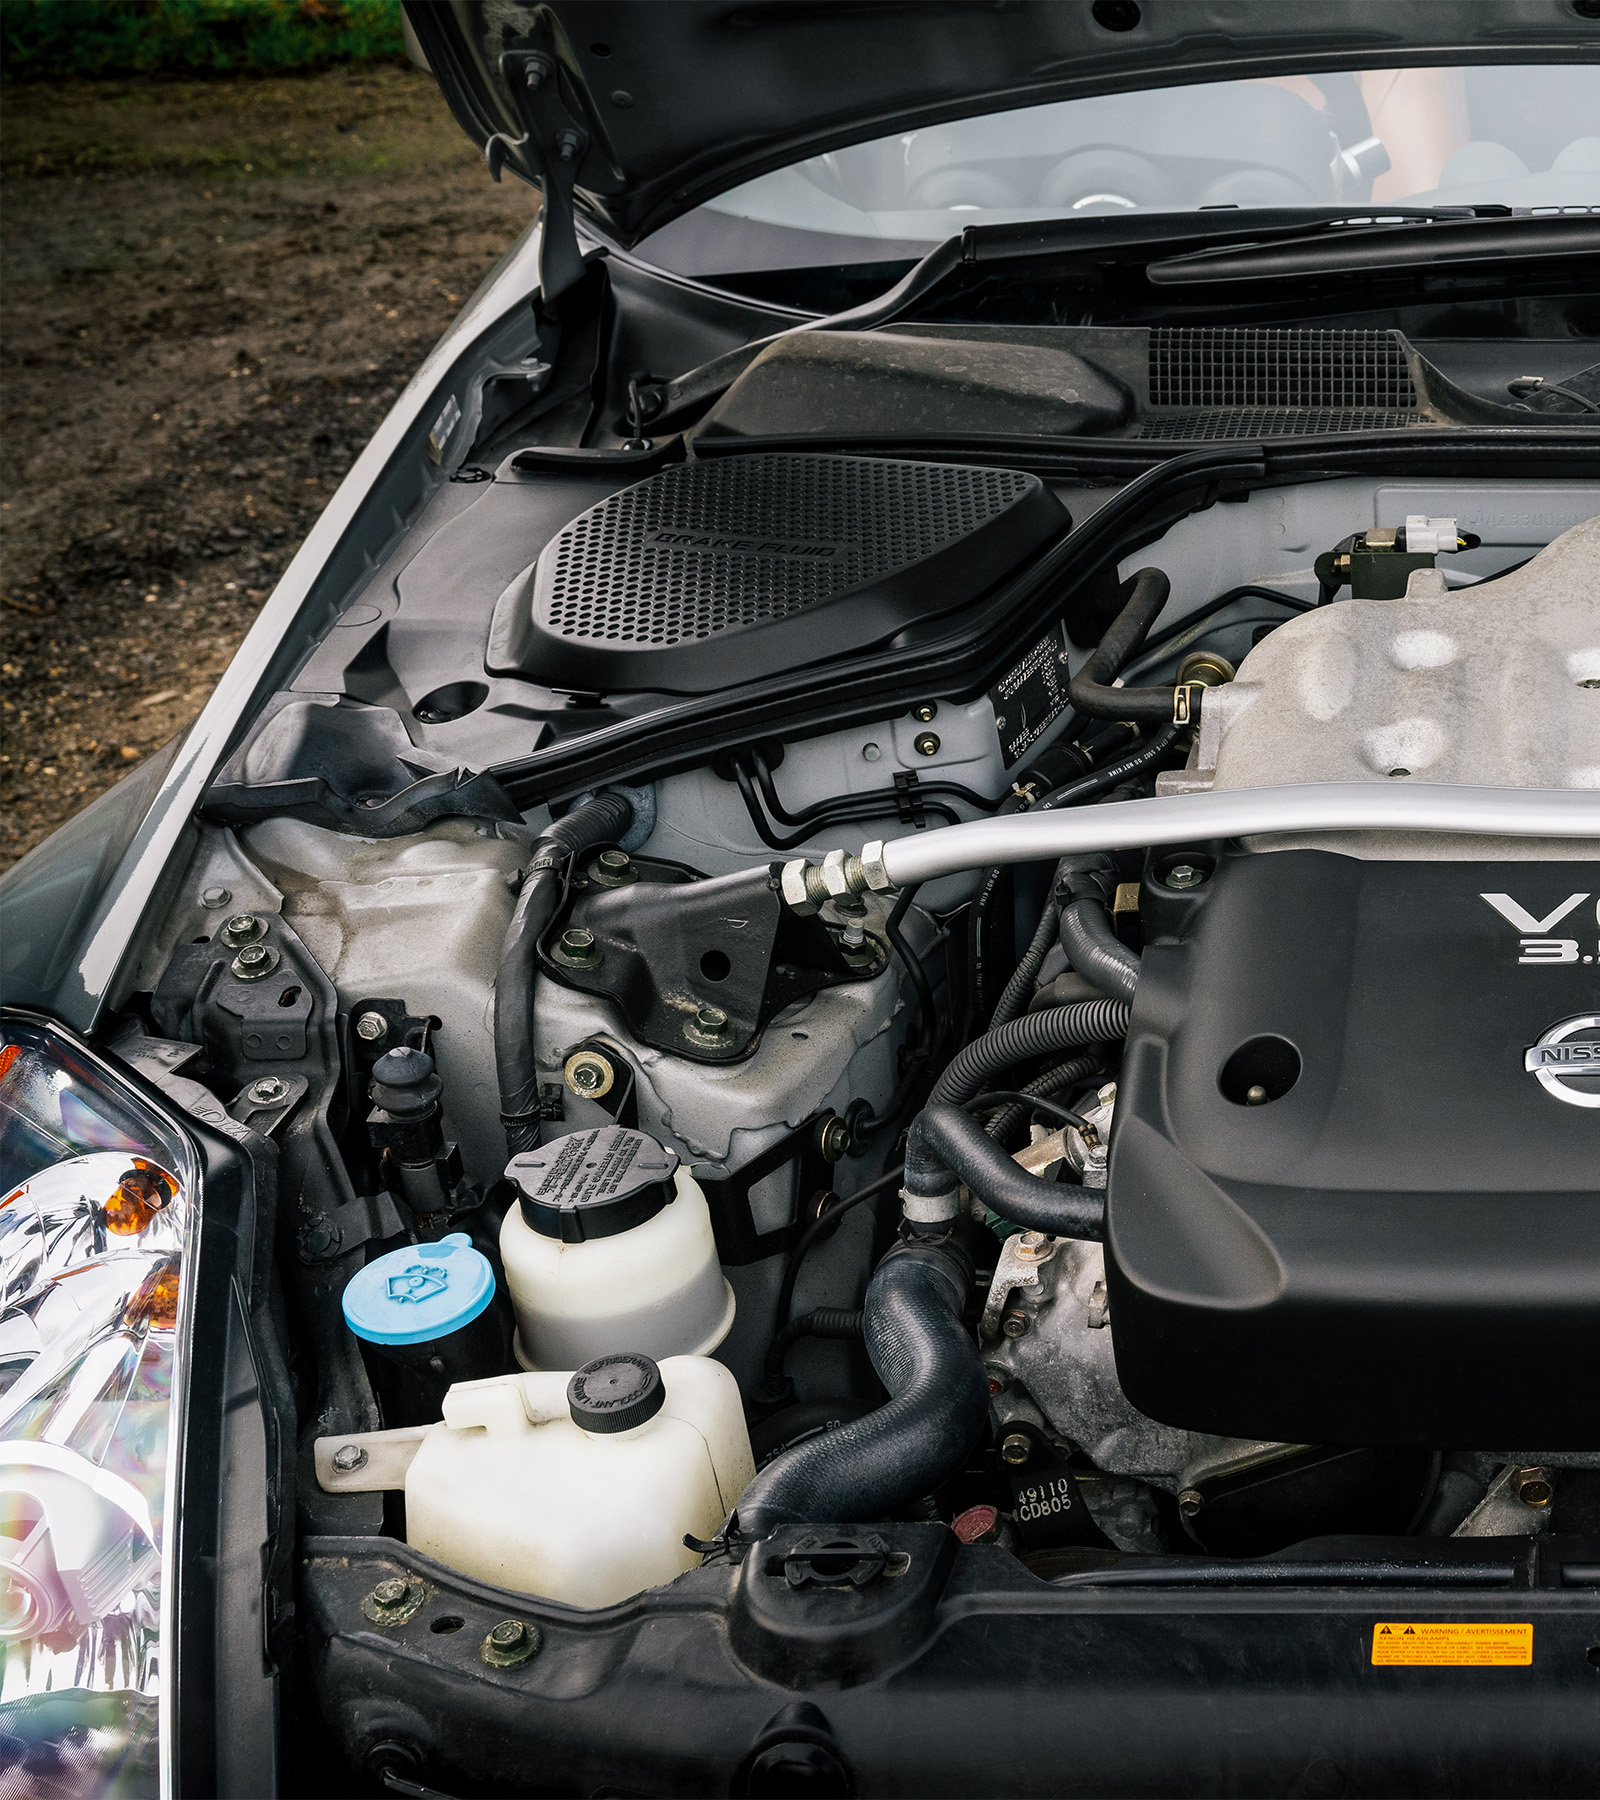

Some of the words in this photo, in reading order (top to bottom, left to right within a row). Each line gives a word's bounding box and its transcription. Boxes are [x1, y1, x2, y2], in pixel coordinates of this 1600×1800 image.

[654, 533, 754, 550] BRAKE
[757, 543, 837, 557] FLUID
[1123, 762, 1135, 771] NOT
[1134, 757, 1143, 765] DO
[1108, 767, 1123, 777] KINK
[1018, 1478, 1068, 1504] 49110
[1020, 1494, 1072, 1521] CD805
